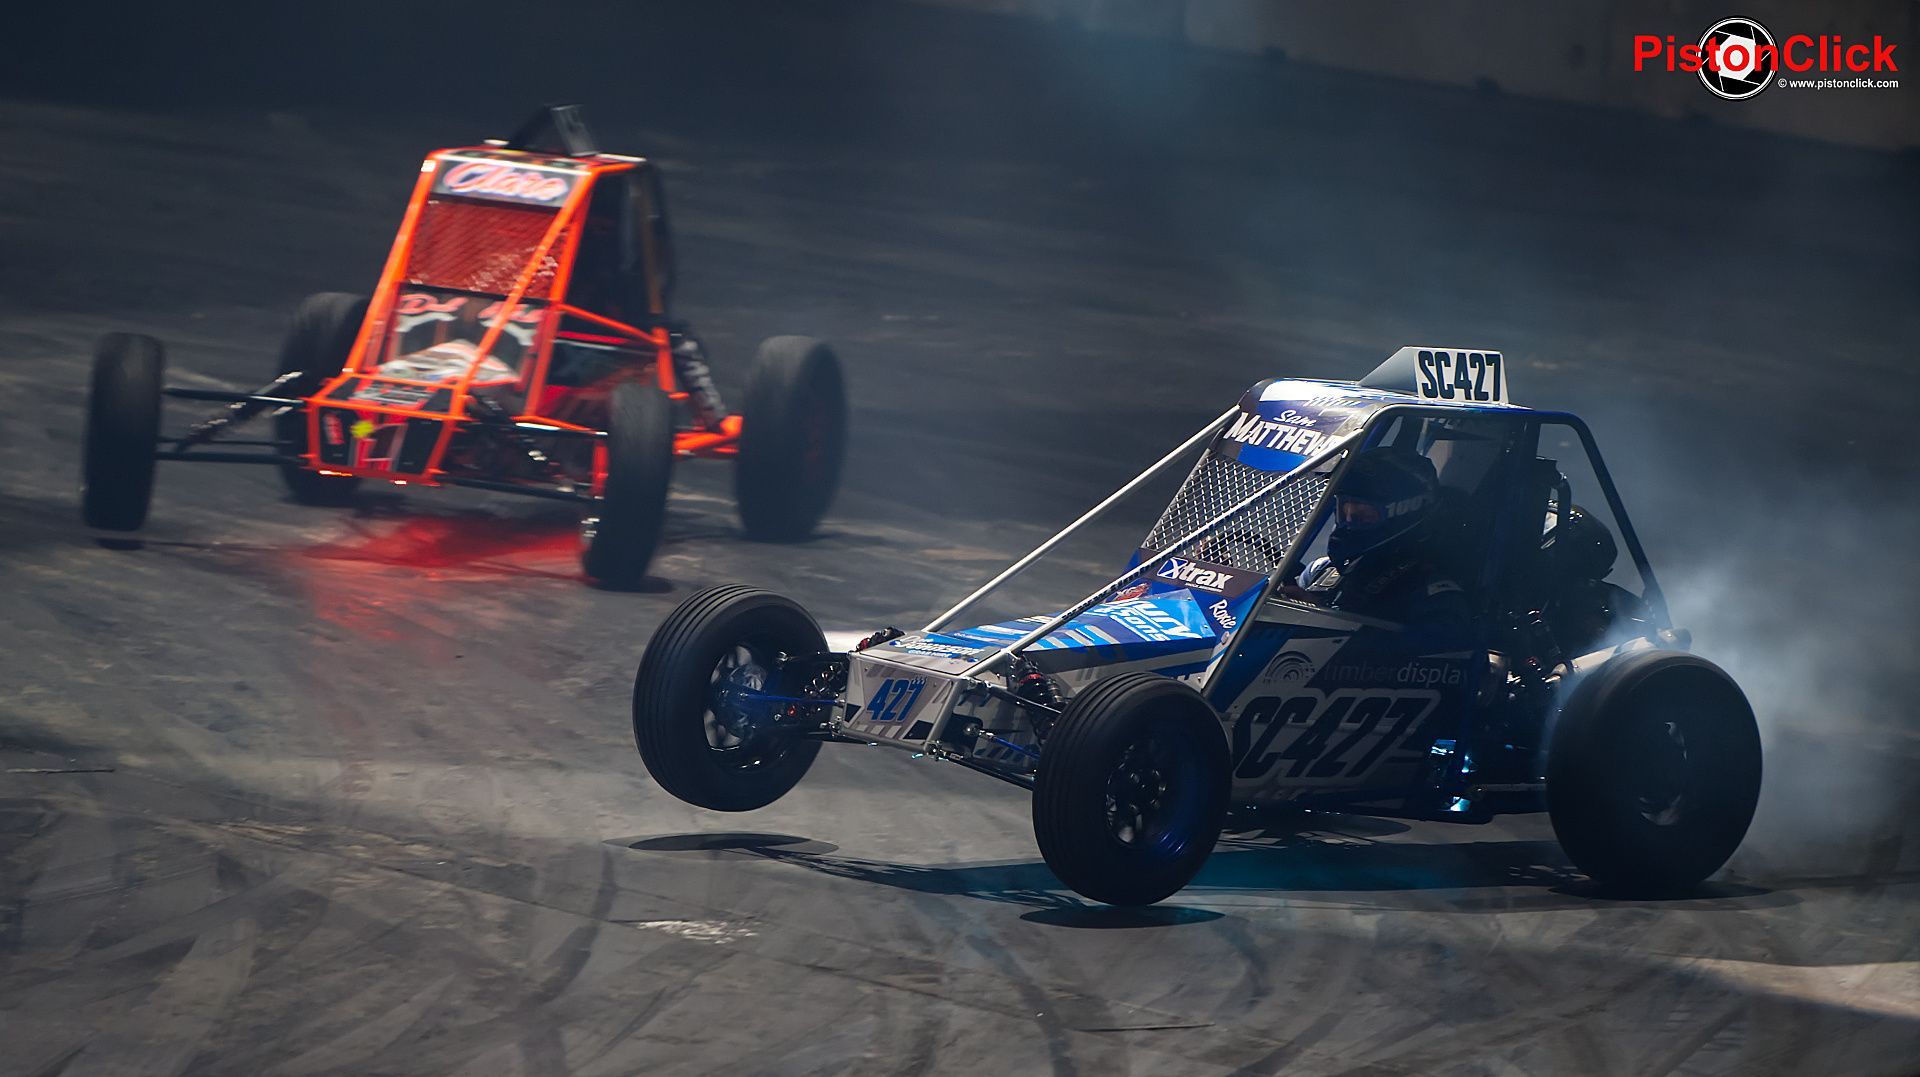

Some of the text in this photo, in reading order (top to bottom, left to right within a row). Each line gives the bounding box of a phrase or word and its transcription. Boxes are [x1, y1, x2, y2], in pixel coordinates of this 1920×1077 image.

[1418, 350, 1501, 402] SC427
[1273, 409, 1317, 427] Sam
[1157, 556, 1234, 590] Xtrax
[1208, 599, 1237, 630] Roxie
[866, 675, 927, 722] 427
[1234, 696, 1433, 779] SC427
